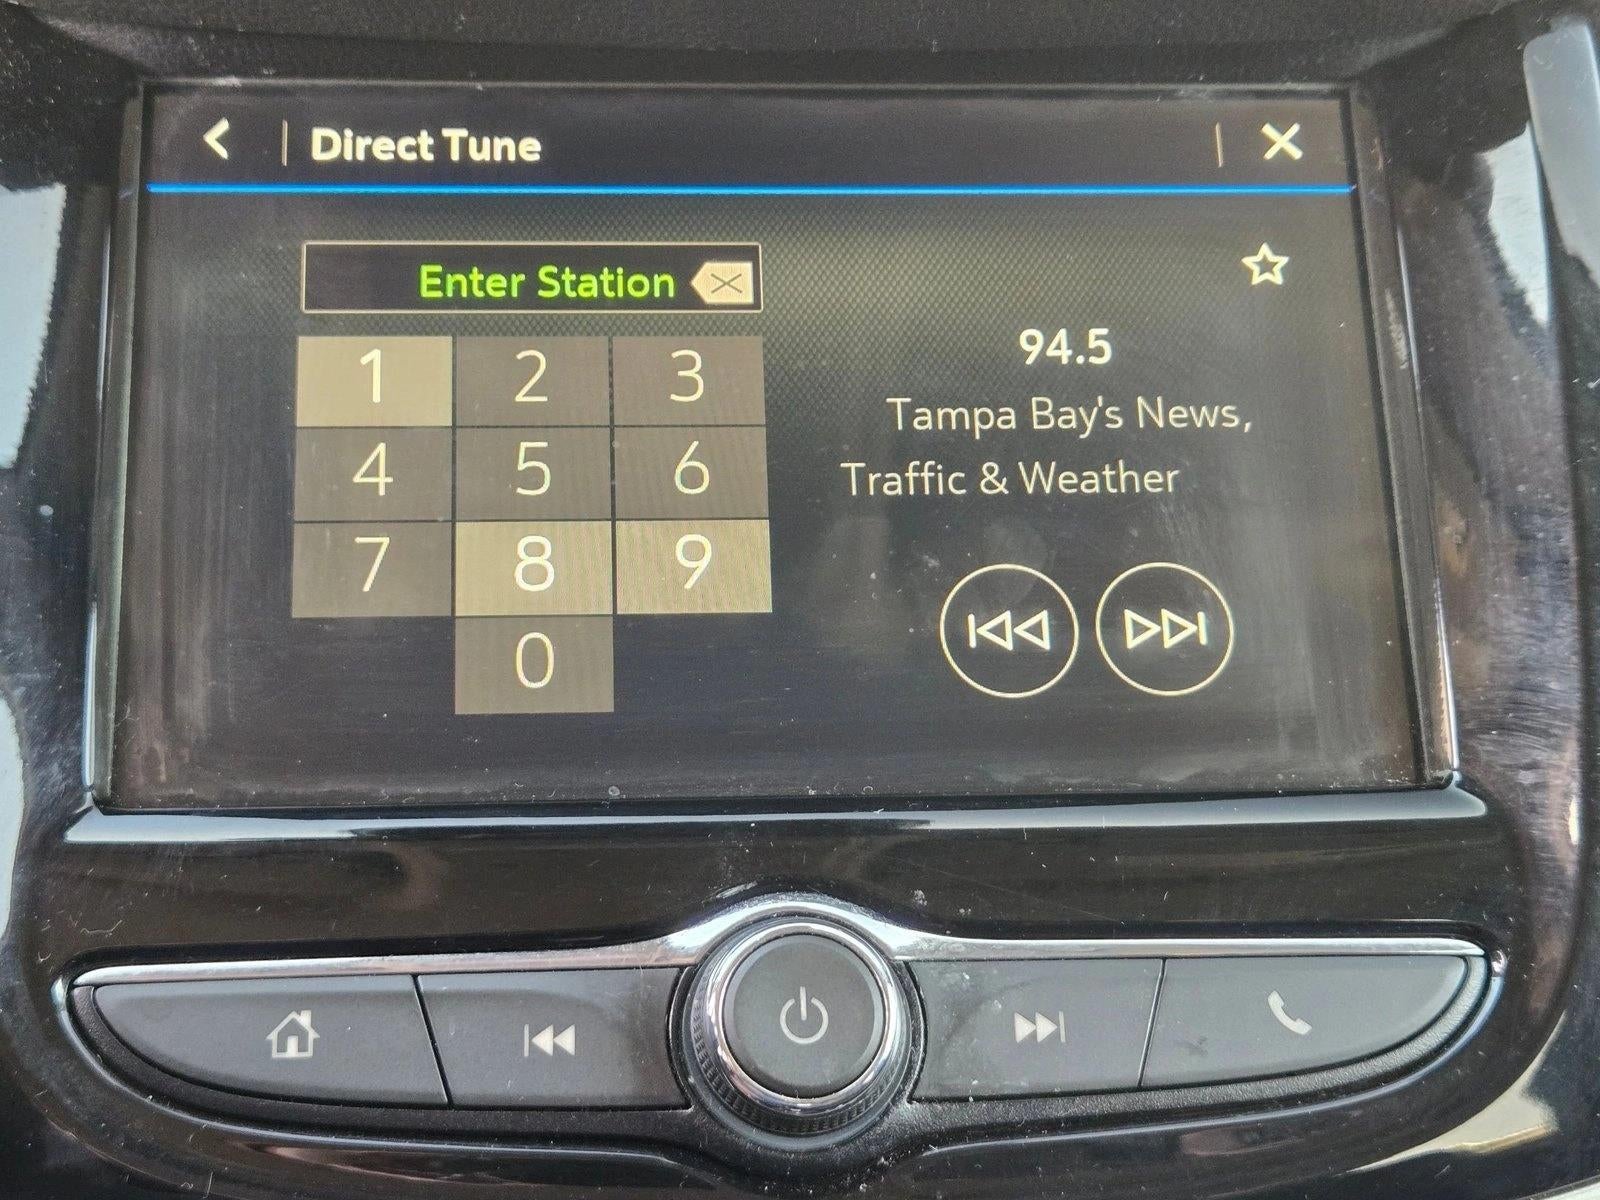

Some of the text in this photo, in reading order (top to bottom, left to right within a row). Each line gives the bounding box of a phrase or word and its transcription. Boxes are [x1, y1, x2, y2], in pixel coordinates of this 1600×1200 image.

[310, 127, 543, 163] Direct Tune
[419, 264, 676, 299] Enter Station
[1018, 327, 1113, 366] 94.5
[359, 348, 382, 404] 1
[514, 349, 549, 403] 2
[669, 349, 705, 404] 3
[886, 395, 1252, 440] Tampa Bay's News,
[352, 441, 395, 497] 4
[515, 441, 552, 497] 5
[673, 440, 711, 496] 6
[839, 459, 1180, 497] Traffic & Weather
[354, 536, 391, 593] 7
[513, 535, 556, 593] 8
[675, 534, 713, 590] 9
[514, 632, 556, 690] 0
